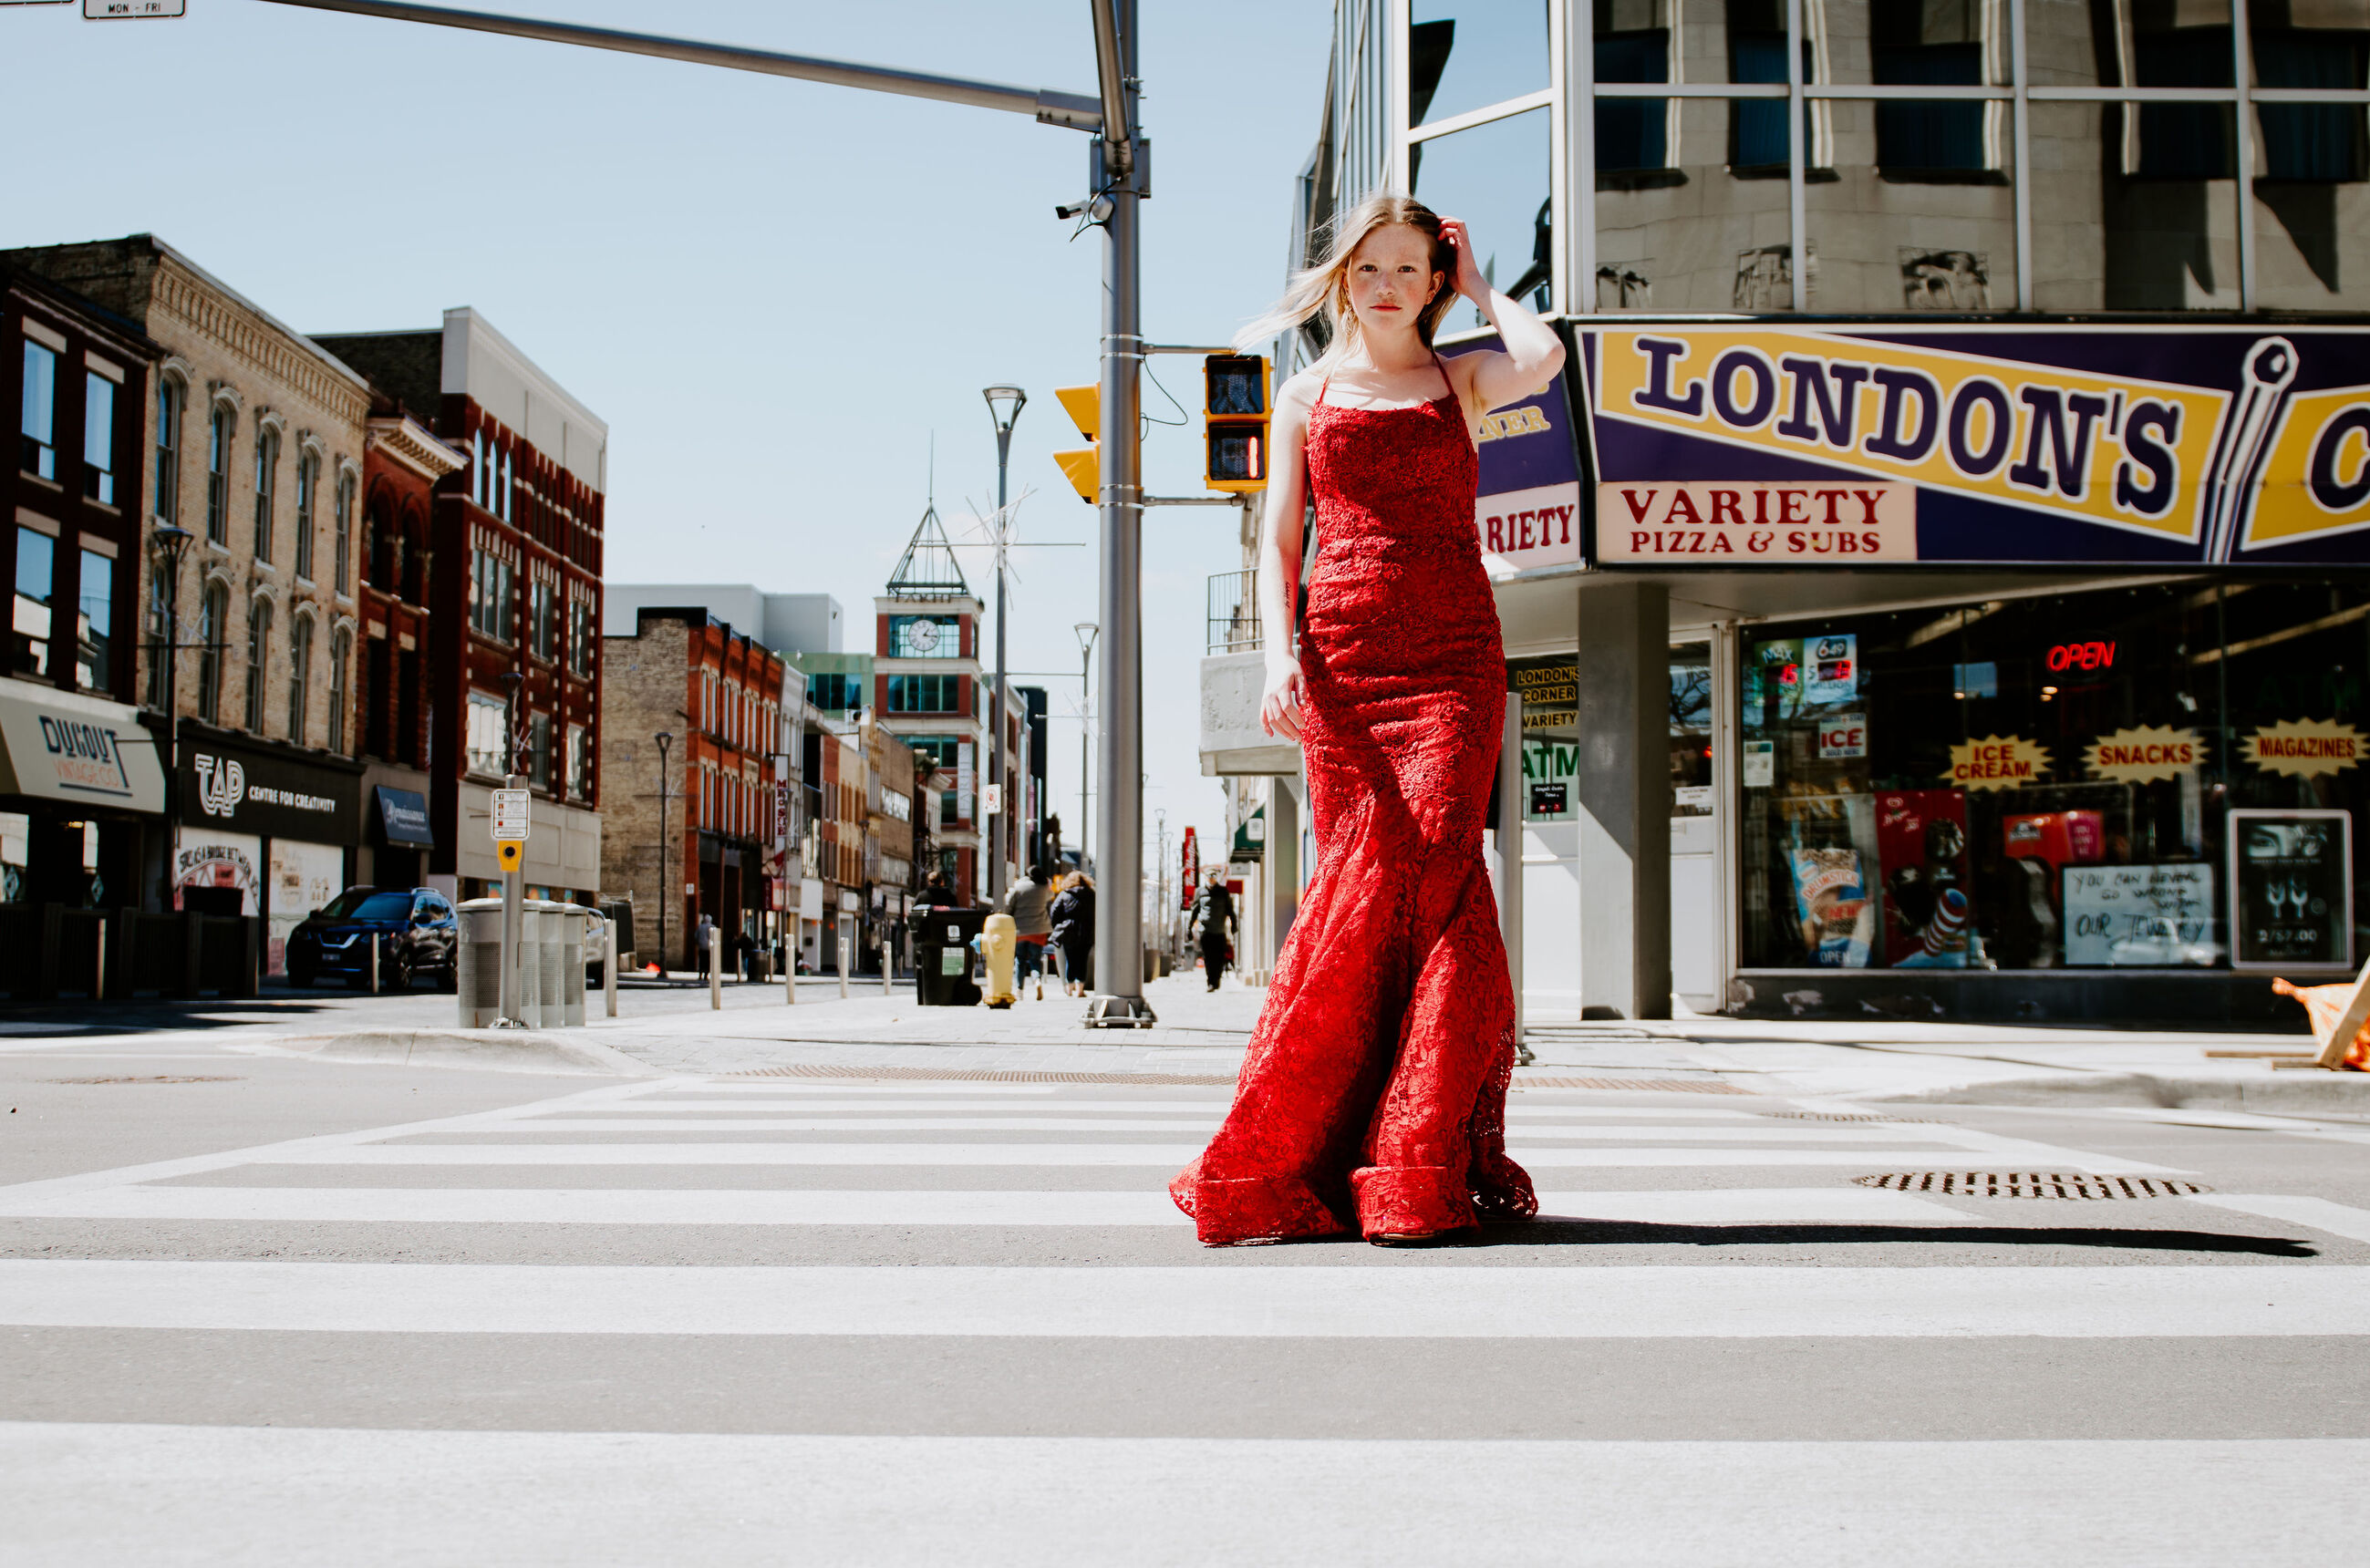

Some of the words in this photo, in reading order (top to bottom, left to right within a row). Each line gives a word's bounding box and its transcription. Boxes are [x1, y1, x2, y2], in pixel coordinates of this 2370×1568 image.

[108, 4, 129, 14] MON
[145, 3, 161, 13] FRI
[1478, 406, 1551, 443] NER
[1634, 335, 2180, 519] LONDON'S
[1620, 489, 1888, 525] VARIETY
[1630, 531, 1734, 553] PIZZA
[1747, 531, 1775, 553] &
[1787, 531, 1880, 553] SUBS
[2045, 640, 2116, 673] OPEN
[1523, 686, 1577, 704] CORNER
[1523, 710, 1578, 727] VARIETY
[1821, 728, 1863, 748] ICE
[2260, 737, 2356, 758] MAGAZINES
[39, 715, 129, 788] DUGOUT
[1523, 746, 1579, 779] ATM
[1973, 744, 2014, 762] ICE
[2099, 743, 2193, 766] SNACKS
[1954, 761, 2033, 780] CREAM
[194, 753, 245, 817] TAP
[248, 785, 278, 804] CENTRE
[279, 790, 294, 807] FOR
[295, 794, 336, 812] CREATIVITY
[1802, 869, 1859, 899] DRUMSTICK
[2073, 873, 2103, 893] YOU
[2114, 872, 2141, 885] CAN
[2076, 913, 2111, 938] OUR
[1820, 950, 1852, 965] OPEN
